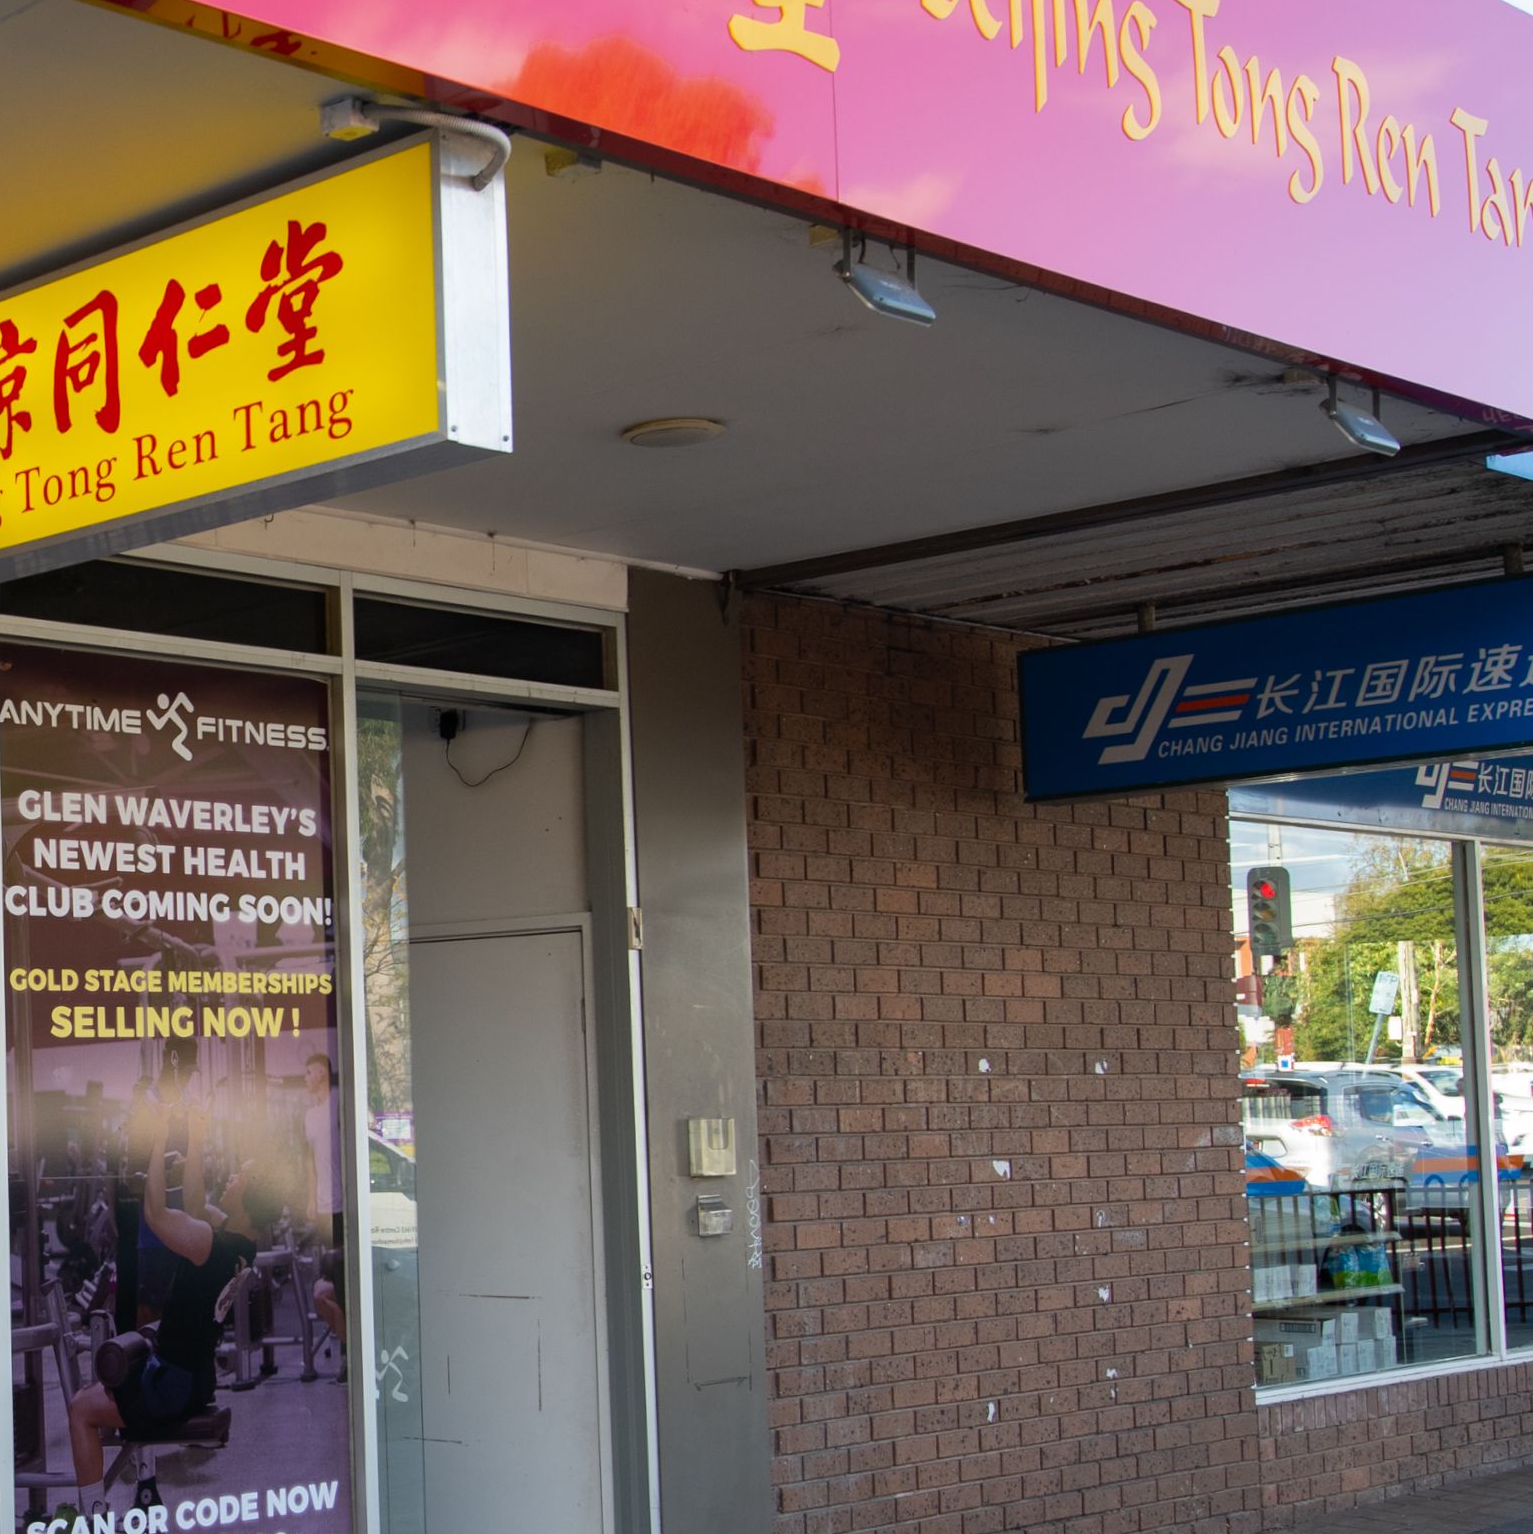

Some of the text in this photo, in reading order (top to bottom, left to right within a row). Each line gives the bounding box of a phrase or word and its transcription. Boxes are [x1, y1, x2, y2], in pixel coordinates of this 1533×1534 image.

[1332, 55, 1441, 218] Ren
[14, 454, 117, 516] Tong
[134, 426, 217, 482] Ren
[233, 387, 354, 454] Tang
[196, 716, 328, 751] FITNESS
[1158, 735, 1223, 759] CHANG
[1230, 727, 1288, 751] JIANG
[1295, 707, 1459, 742] INTERNATIONAL
[18, 790, 317, 837] GLEN WAVERLEY'S
[1444, 797, 1468, 812] CHANG
[1469, 800, 1490, 815] JIANG
[33, 838, 306, 881] NEWEST HEALTH
[4, 886, 333, 926] CLUB COMING SOON!
[9, 968, 333, 995] GOLD STAGE MEMBERSHIPS
[50, 1005, 195, 1039] SELLING
[203, 1007, 284, 1038] NOW
[175, 1492, 260, 1530] CODE
[266, 1481, 339, 1517] NOW
